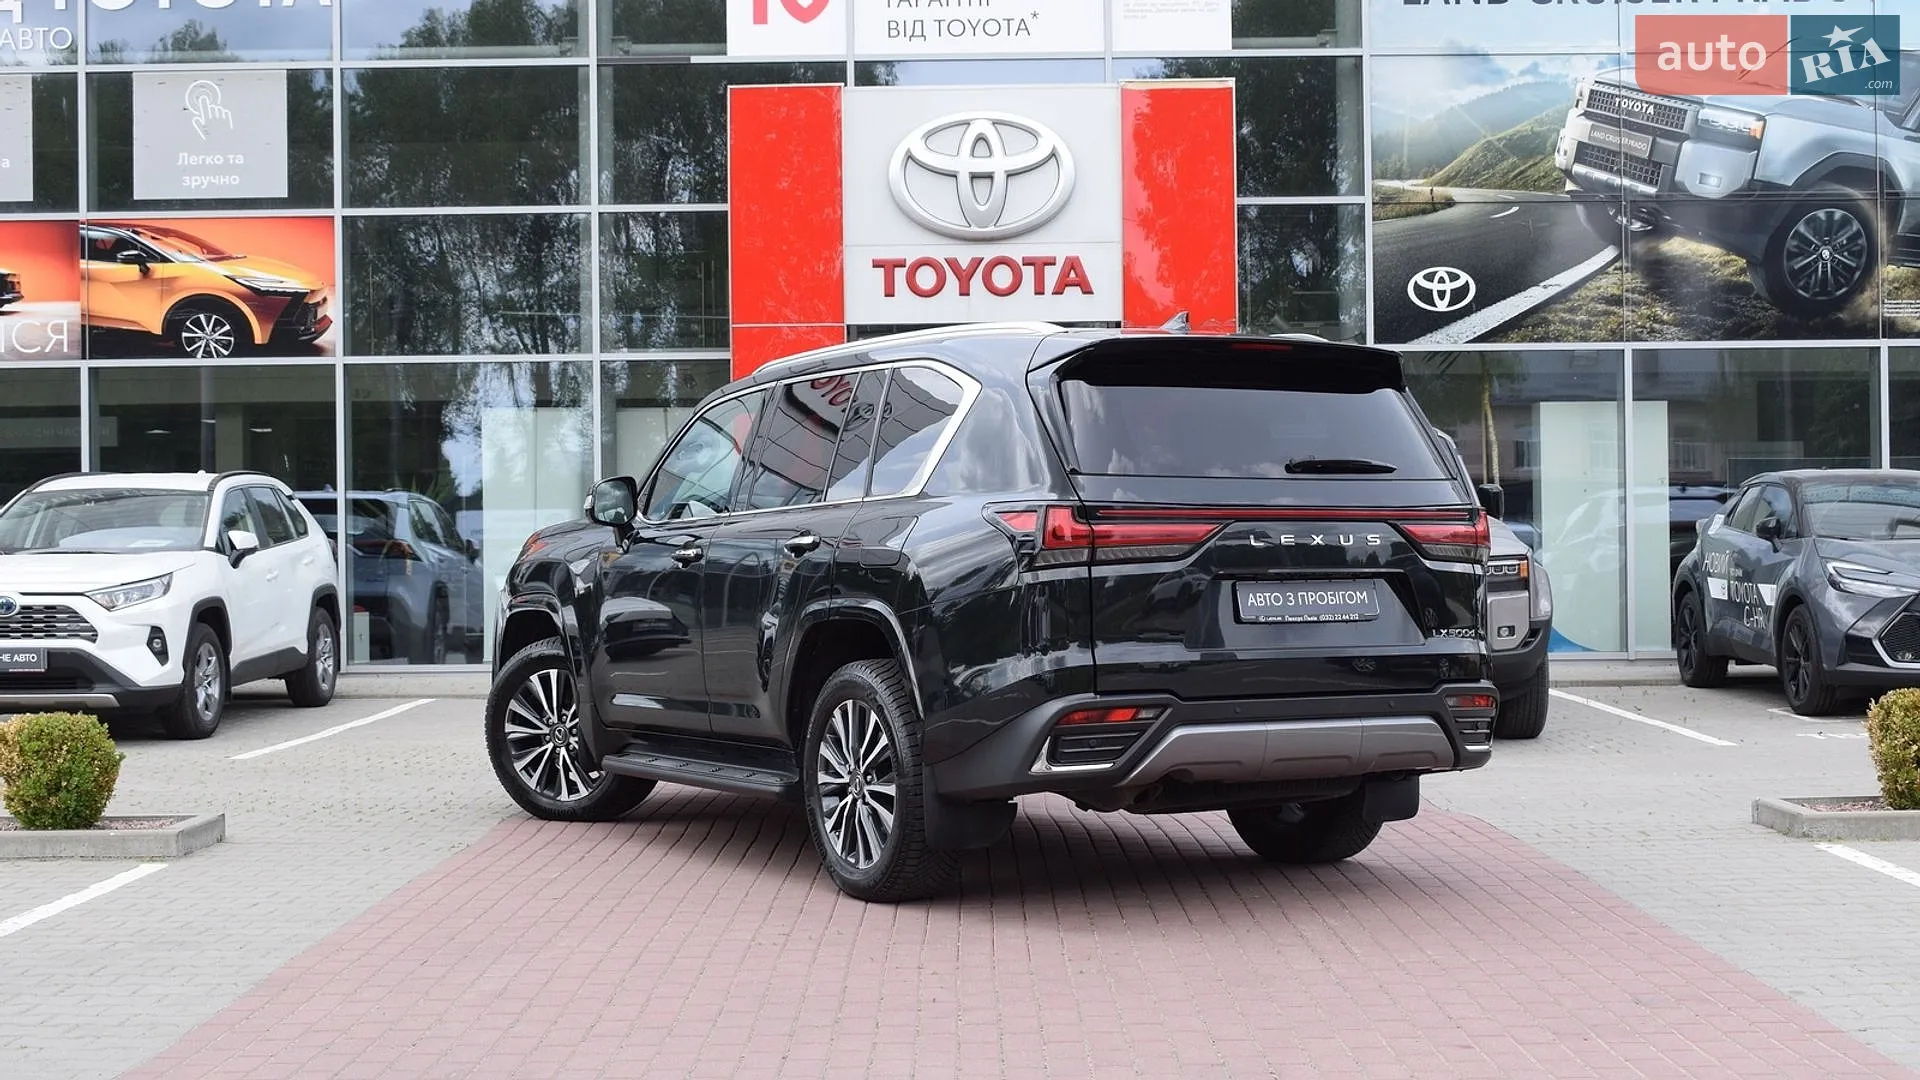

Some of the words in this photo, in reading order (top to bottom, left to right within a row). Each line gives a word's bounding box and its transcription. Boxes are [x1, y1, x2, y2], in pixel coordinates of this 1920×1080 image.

[887, 19, 926, 41] ВІД
[0, 27, 73, 50] АВТО
[1615, 98, 1655, 115] TOYOTA
[176, 152, 224, 166] Легко
[227, 154, 245, 165] та
[182, 175, 241, 189] зручно
[872, 256, 1095, 298] TOYOTA
[1249, 534, 1381, 545] LEXUS
[1247, 592, 1283, 607] АВТО
[1297, 591, 1368, 605] ПРОБІГОМ
[1730, 581, 1759, 604] TOYOTA
[13, 653, 37, 662] АВТО
